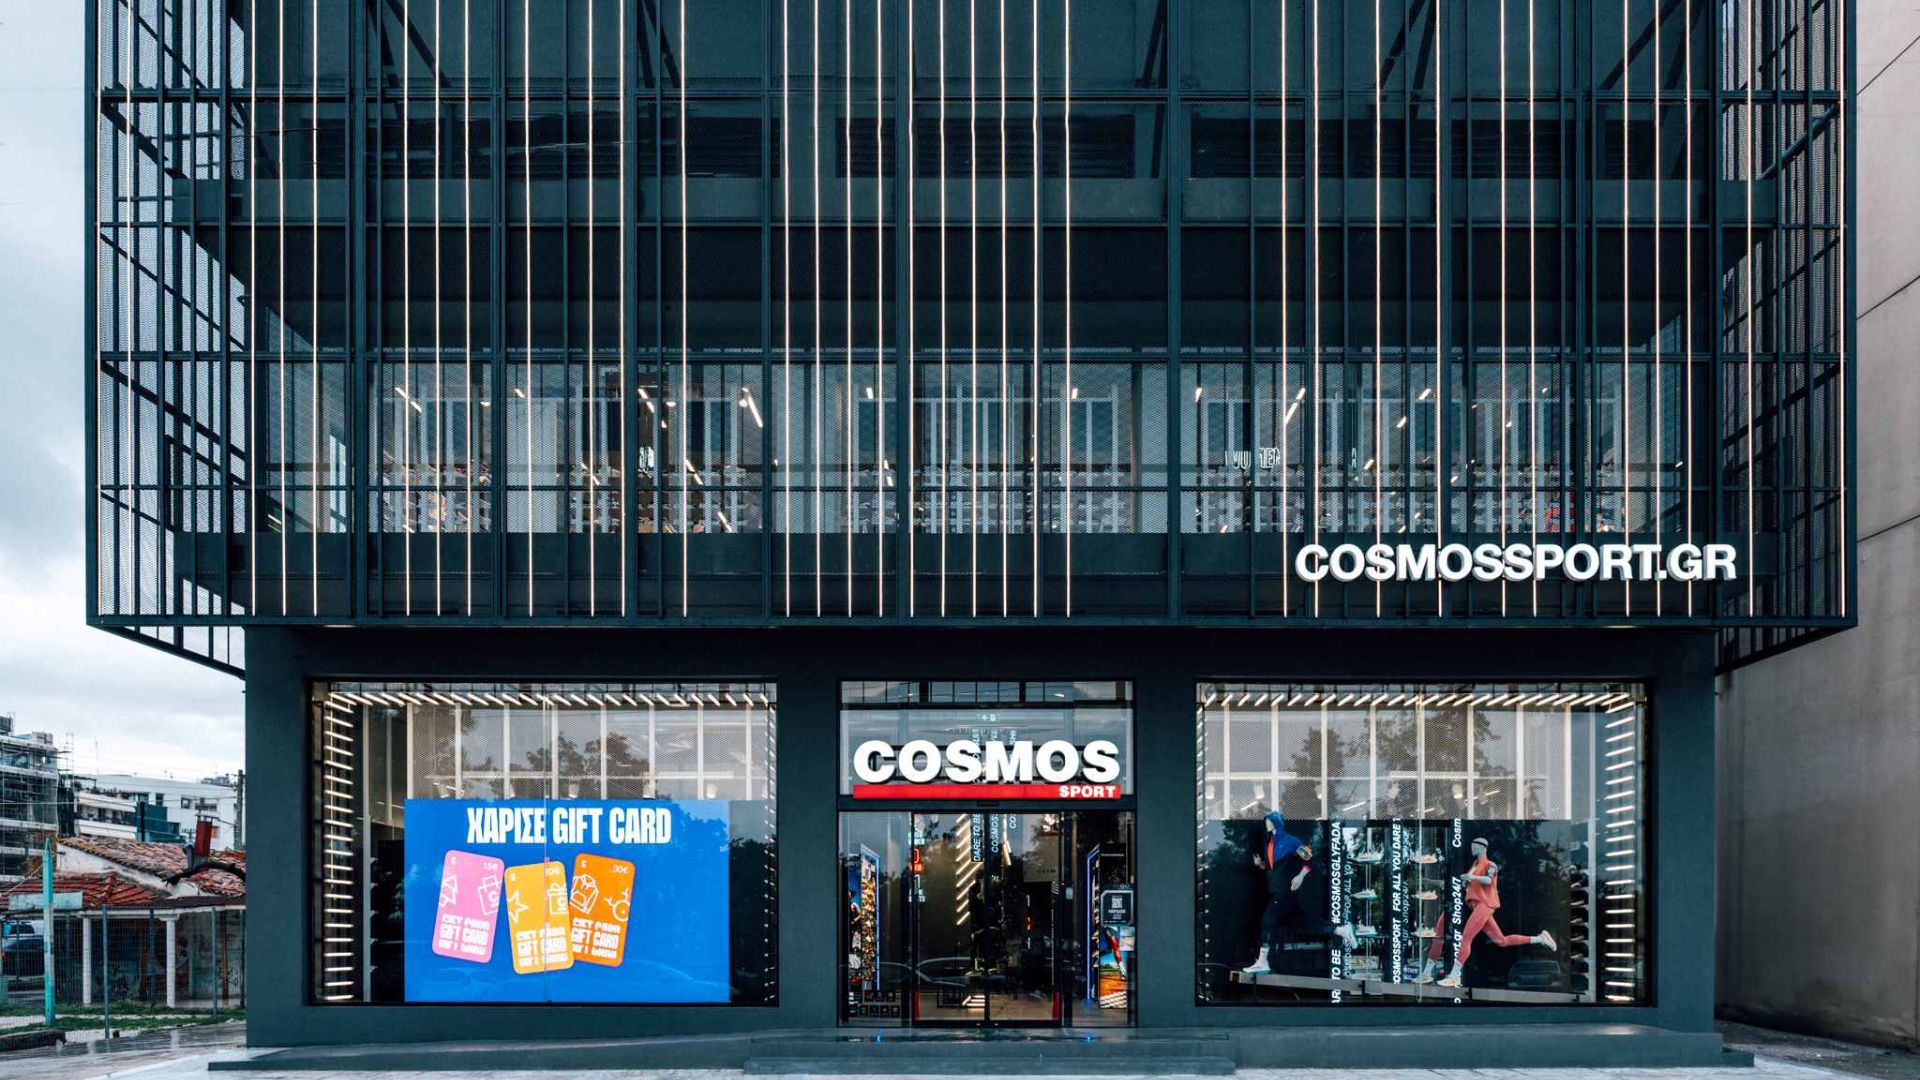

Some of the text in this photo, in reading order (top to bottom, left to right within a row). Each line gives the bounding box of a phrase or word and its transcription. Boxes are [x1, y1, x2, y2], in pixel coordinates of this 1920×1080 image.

[1295, 543, 1737, 582] COSMOSSPORT.GR
[853, 739, 1121, 784] COSMOS
[1058, 785, 1117, 799] SPORT
[466, 807, 672, 845] ΧΑΡΙΣΕ GIFT CARD
[973, 825, 981, 837] TO
[1392, 824, 1401, 850] DARE
[973, 838, 981, 861] DARE
[1392, 851, 1401, 871] YOU
[1331, 822, 1341, 924] #COSMOSGLYFADA
[1392, 873, 1401, 891] ALL
[1392, 892, 1401, 912] FOR
[1452, 876, 1463, 924] Shop24/7
[440, 923, 489, 945] GIFT CARD
[571, 927, 619, 949] GIFT CARD
[517, 937, 567, 957] GIFT CARD
[1331, 949, 1341, 965] BE
[1331, 967, 1341, 980] TO
